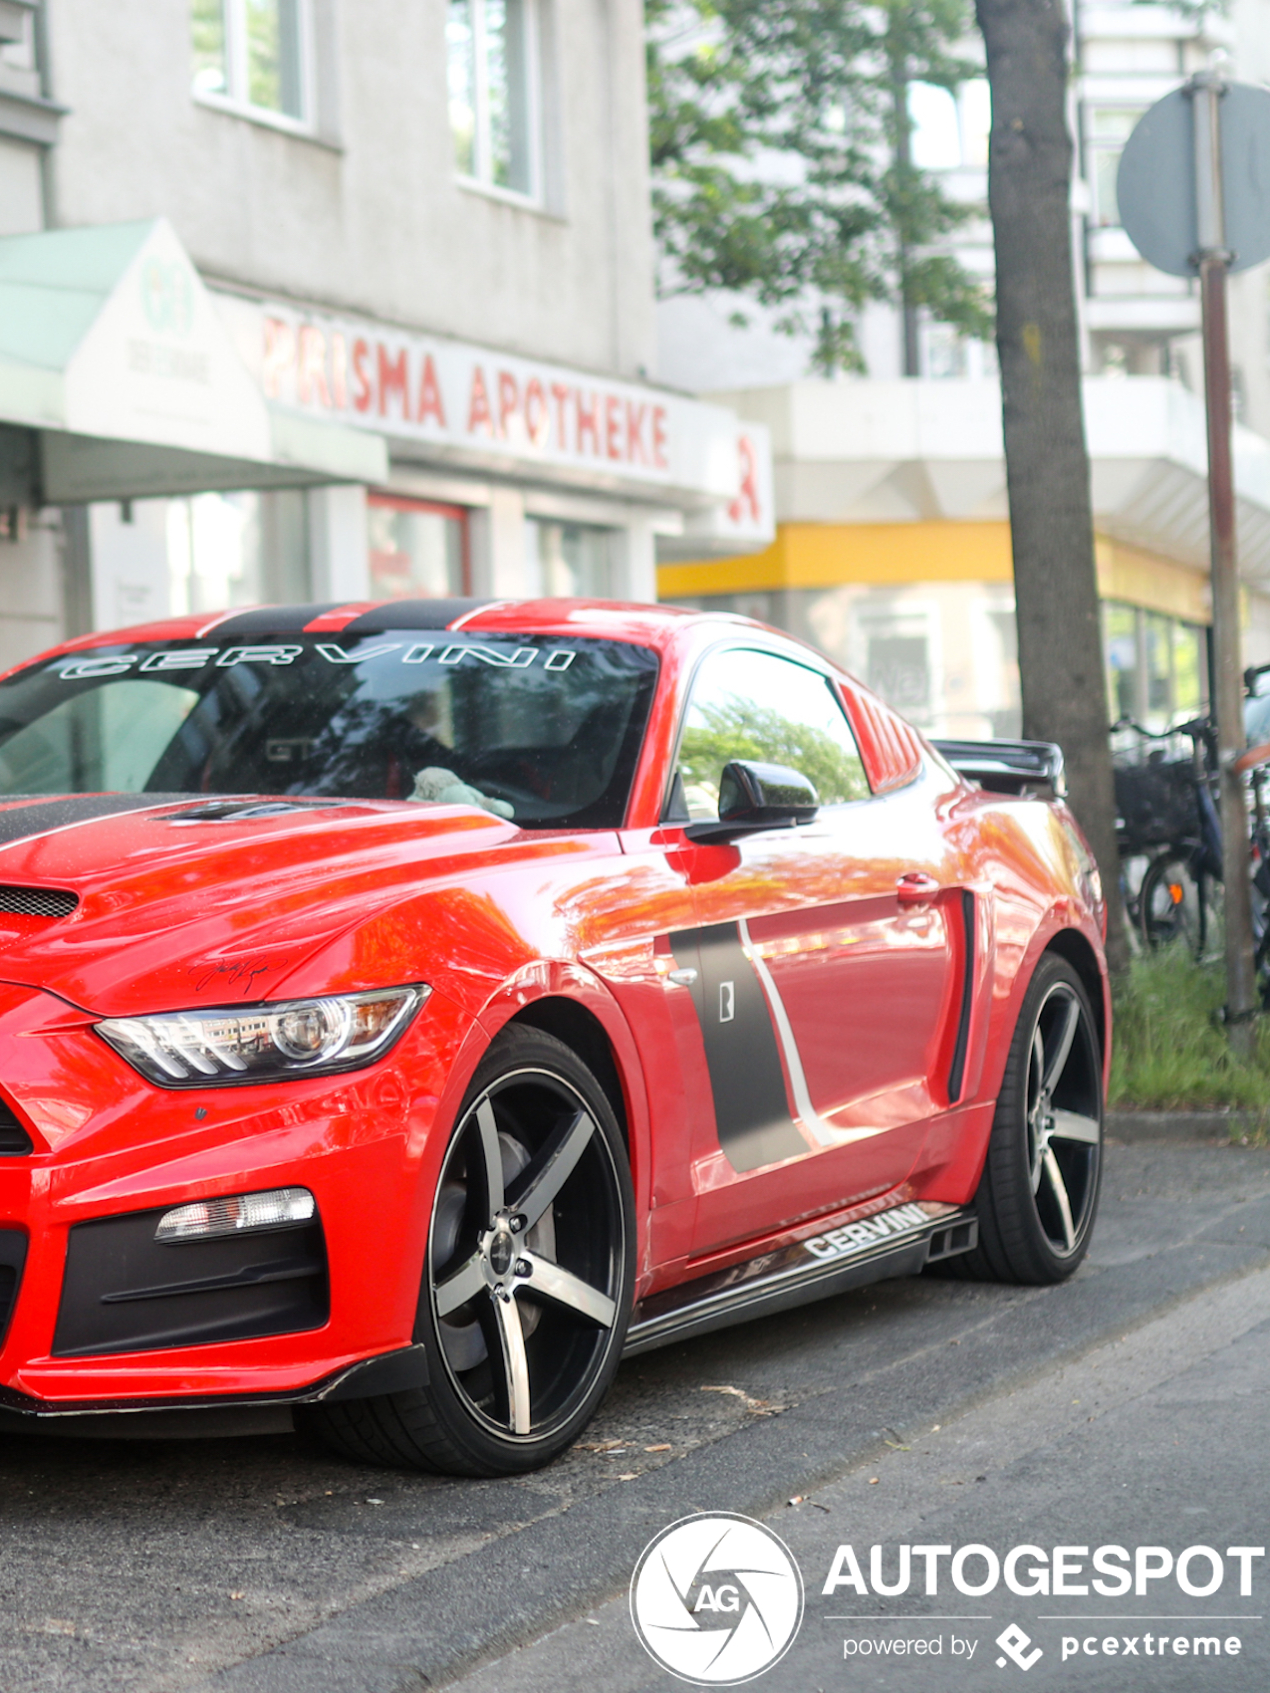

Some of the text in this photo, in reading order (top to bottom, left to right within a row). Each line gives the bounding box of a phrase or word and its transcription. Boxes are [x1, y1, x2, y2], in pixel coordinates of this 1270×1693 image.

[263, 317, 448, 432] PRISMA
[465, 364, 670, 470] APOTHEKE
[60, 643, 577, 680] CERVINI
[803, 1203, 930, 1259] CERVINI
